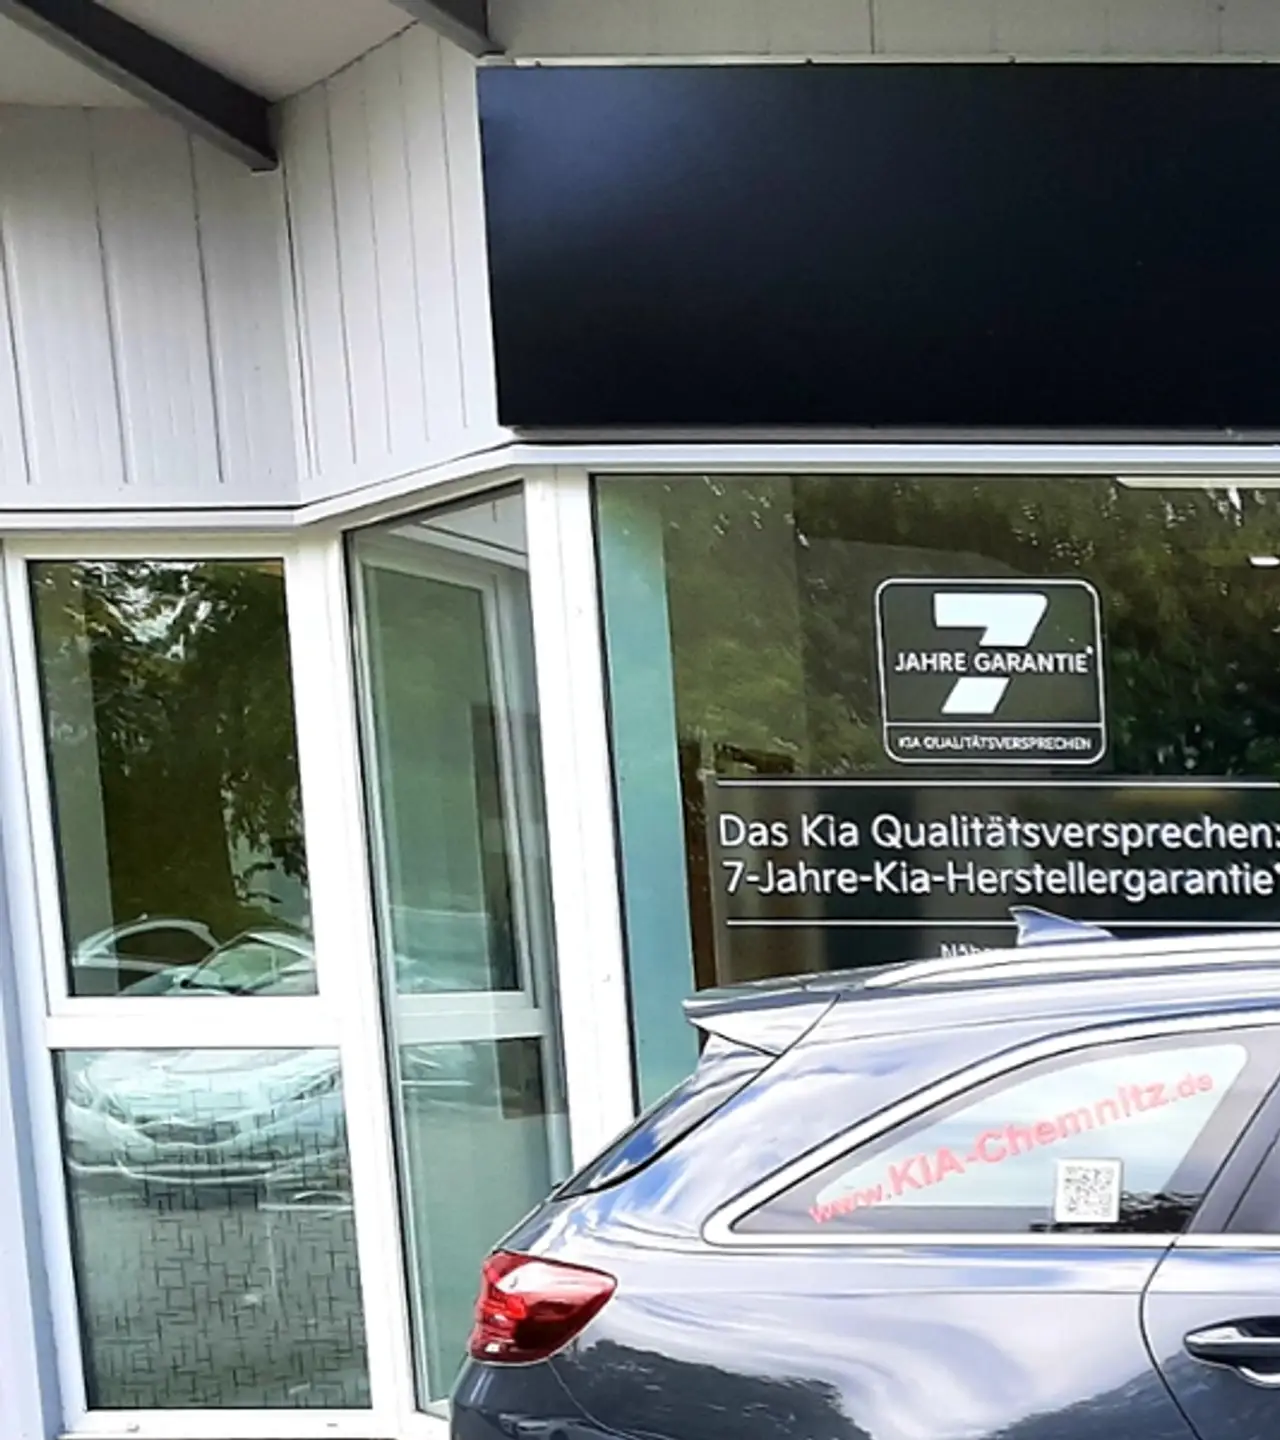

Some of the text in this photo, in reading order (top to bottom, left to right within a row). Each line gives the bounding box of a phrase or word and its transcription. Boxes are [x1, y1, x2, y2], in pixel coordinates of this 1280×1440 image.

[895, 652, 968, 673] JAHRE
[898, 735, 921, 749] KIA
[719, 815, 789, 849] Das
[801, 814, 858, 849] Kia
[808, 1072, 1214, 1224] www.KIA-Chemnitz.de
